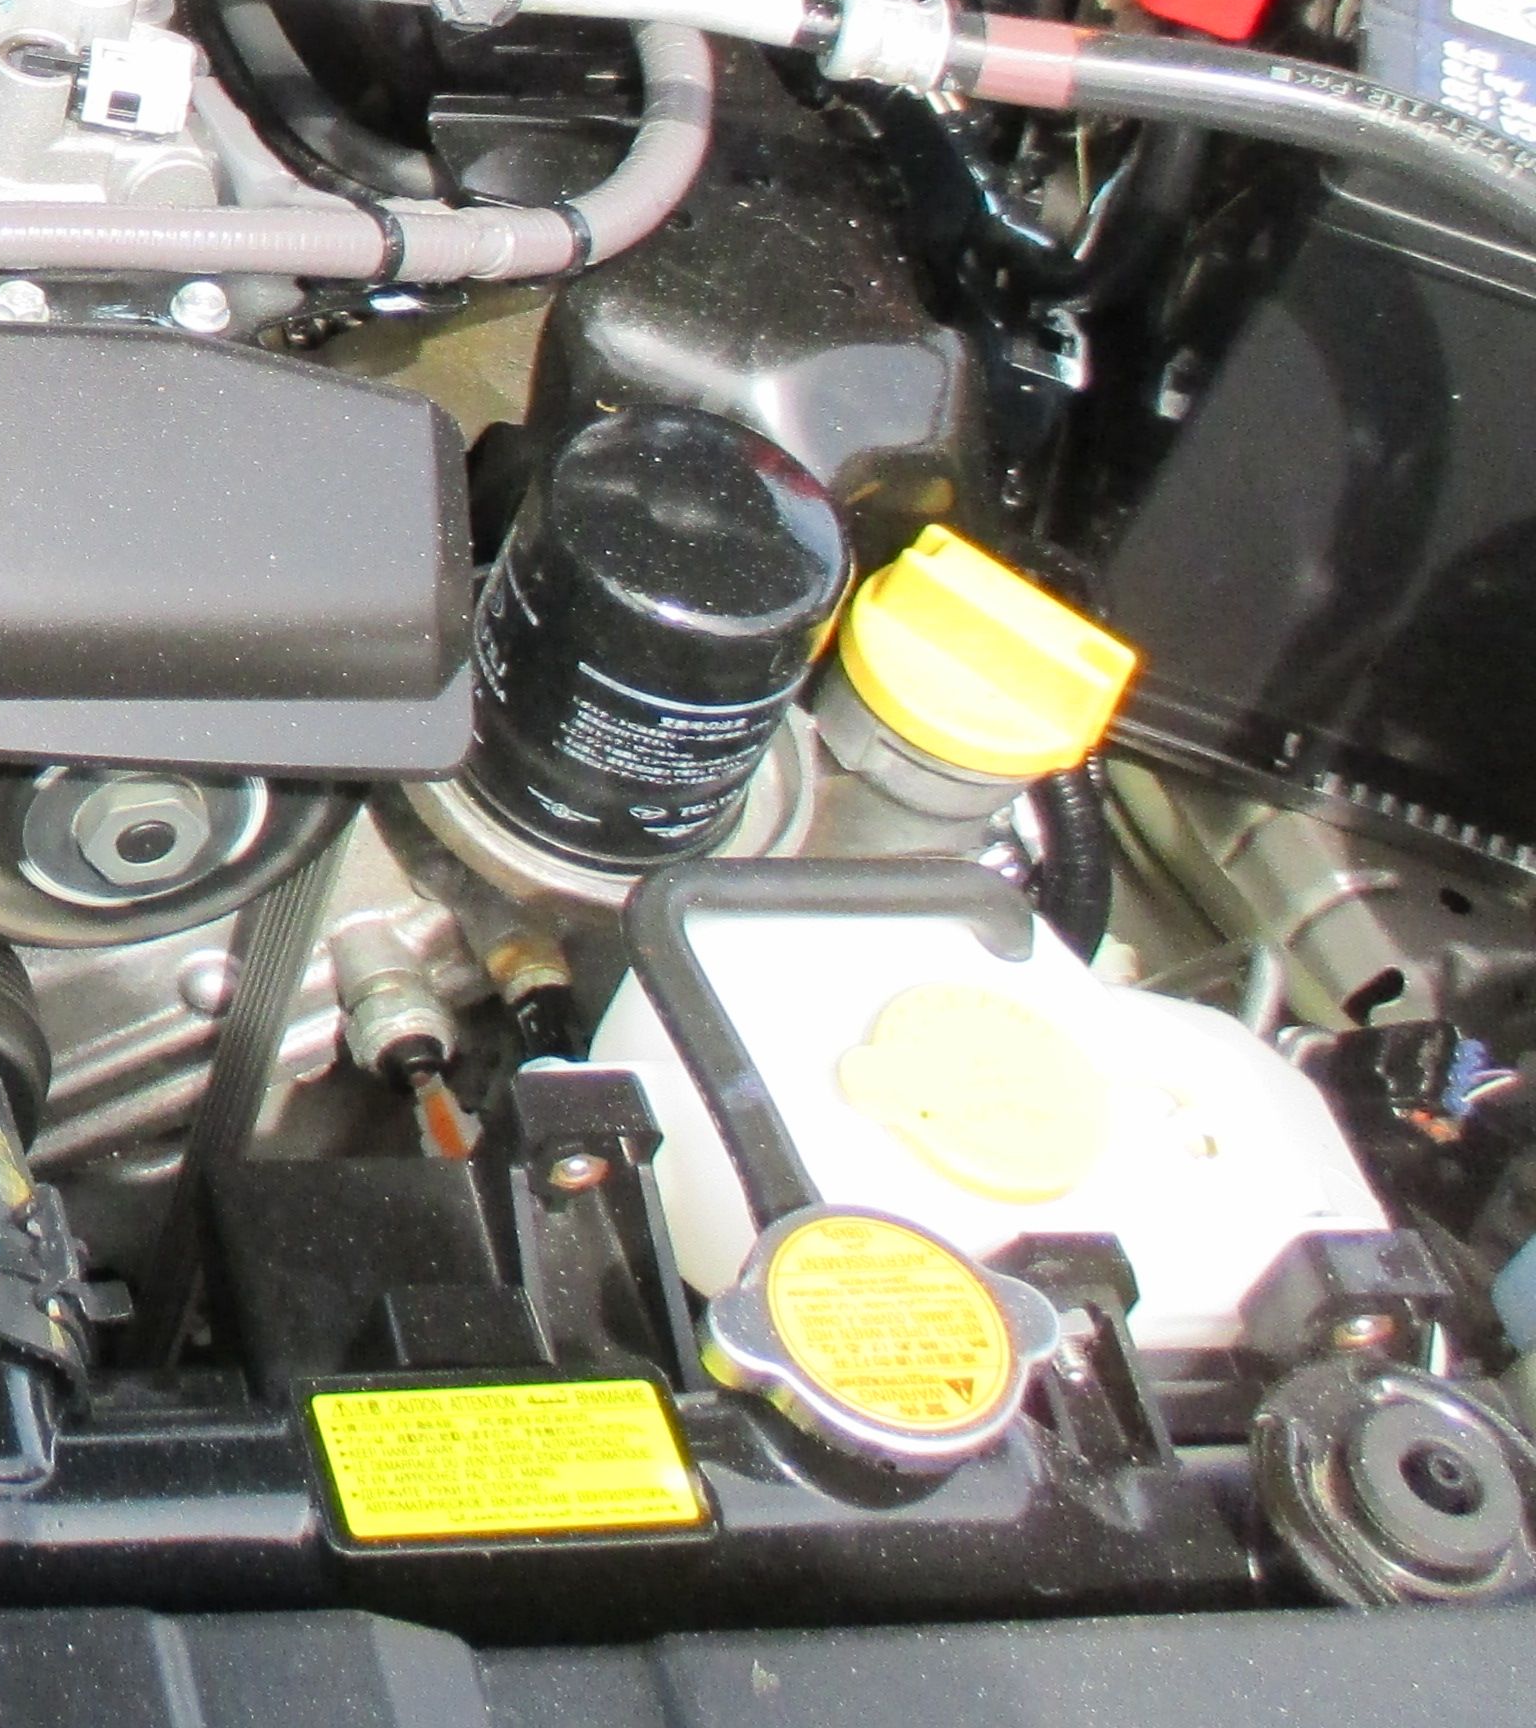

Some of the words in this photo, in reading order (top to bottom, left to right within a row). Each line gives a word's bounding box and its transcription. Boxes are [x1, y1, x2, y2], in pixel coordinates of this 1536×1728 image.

[798, 1254, 925, 1271] AVERTISSEMENT
[800, 1315, 842, 1328] CHAUD
[911, 1310, 955, 1323] JAMAIS
[805, 1329, 833, 1342] HOT
[840, 1327, 885, 1341] WHEN
[889, 1324, 928, 1339] OPEN
[935, 1322, 984, 1337] NEVER
[858, 1387, 945, 1404] WARNING
[387, 1397, 443, 1413] CAUTION
[449, 1395, 516, 1410] ATTENTION
[382, 1446, 420, 1455] HANDS
[467, 1442, 488, 1451] FAN
